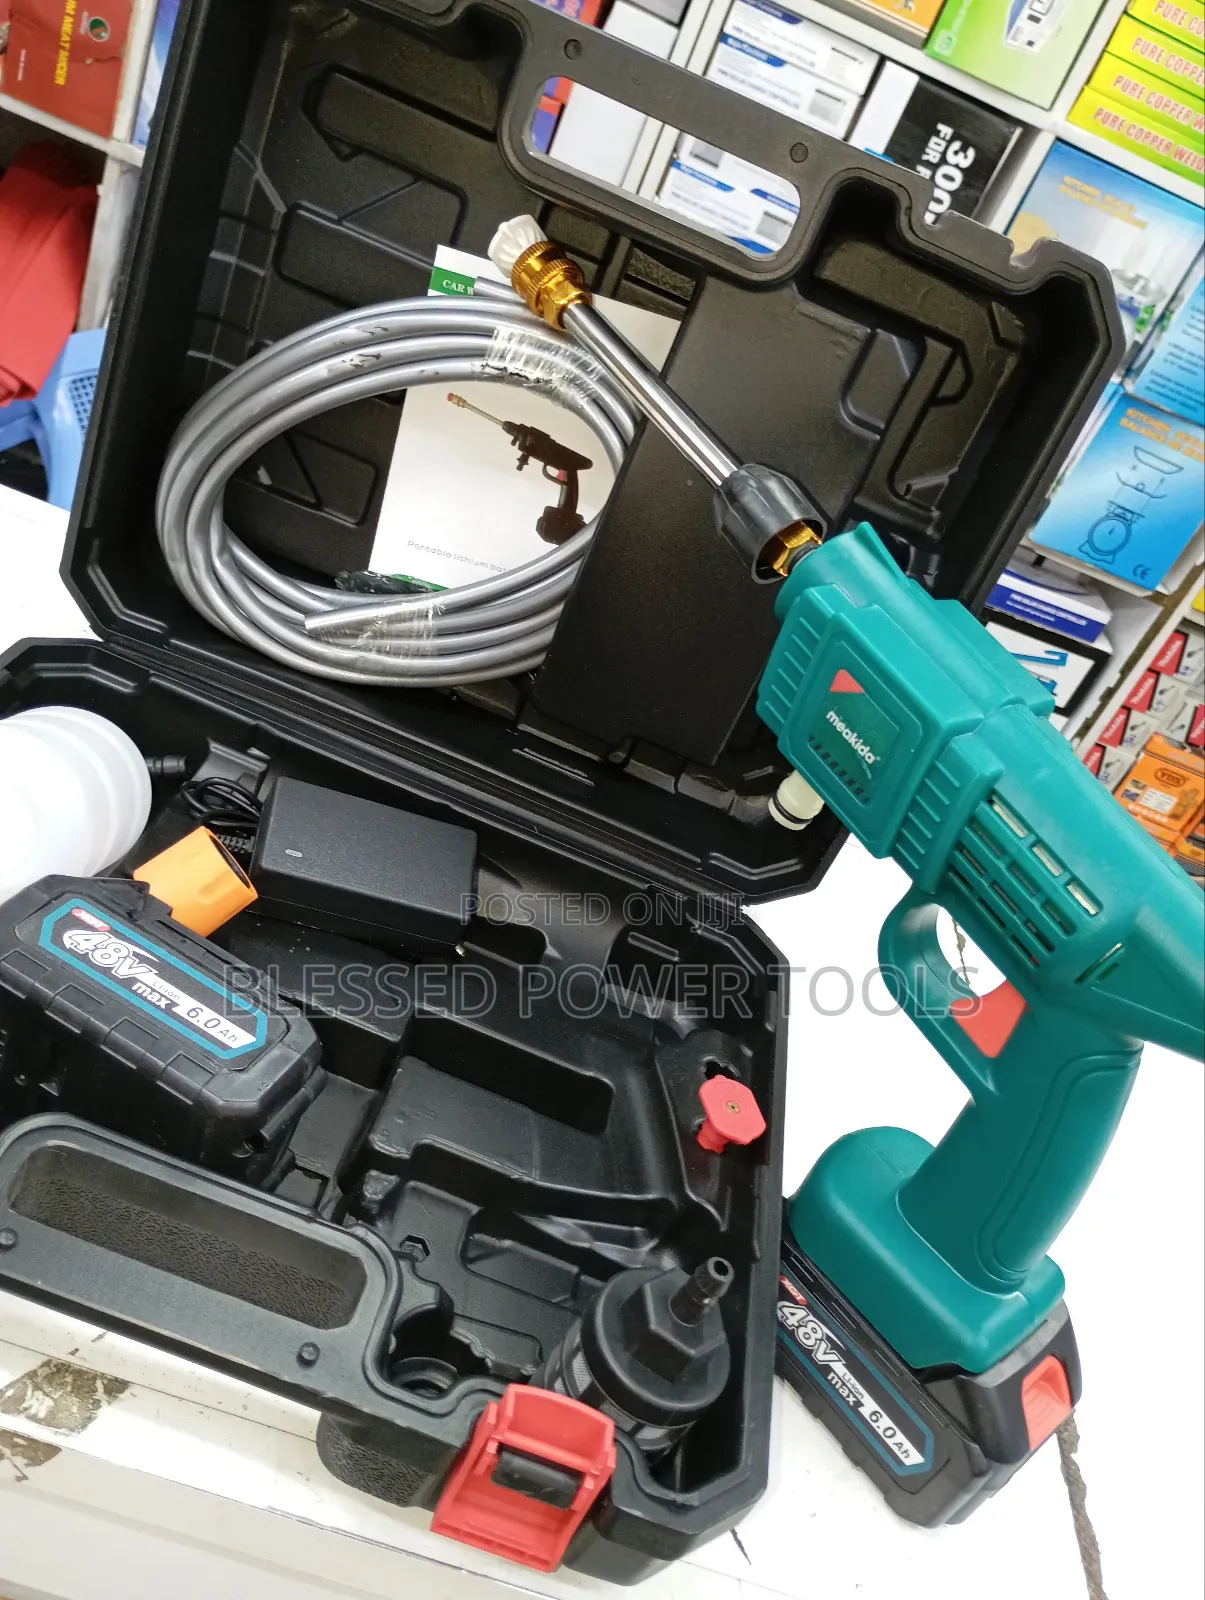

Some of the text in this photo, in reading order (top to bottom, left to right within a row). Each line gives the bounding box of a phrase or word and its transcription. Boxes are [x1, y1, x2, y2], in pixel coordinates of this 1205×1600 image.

[1154, 0, 1187, 26] PURE
[1132, 37, 1164, 63] PURE
[1113, 75, 1146, 100] PURE
[1146, 91, 1193, 125] COPPER
[921, 122, 954, 164] FOR
[1094, 107, 1126, 132] PURE
[1126, 124, 1173, 156] COPPER
[442, 279, 465, 293] CAR
[407, 540, 452, 559] Portable
[453, 553, 488, 570] lithium
[825, 710, 876, 764] meakida
[65, 931, 158, 979] 48V
[131, 981, 239, 1043] max 6.0 Ah
[781, 1278, 805, 1303] XGT
[777, 1304, 846, 1365] 48V
[827, 1371, 912, 1460] max 6.0 Ah
